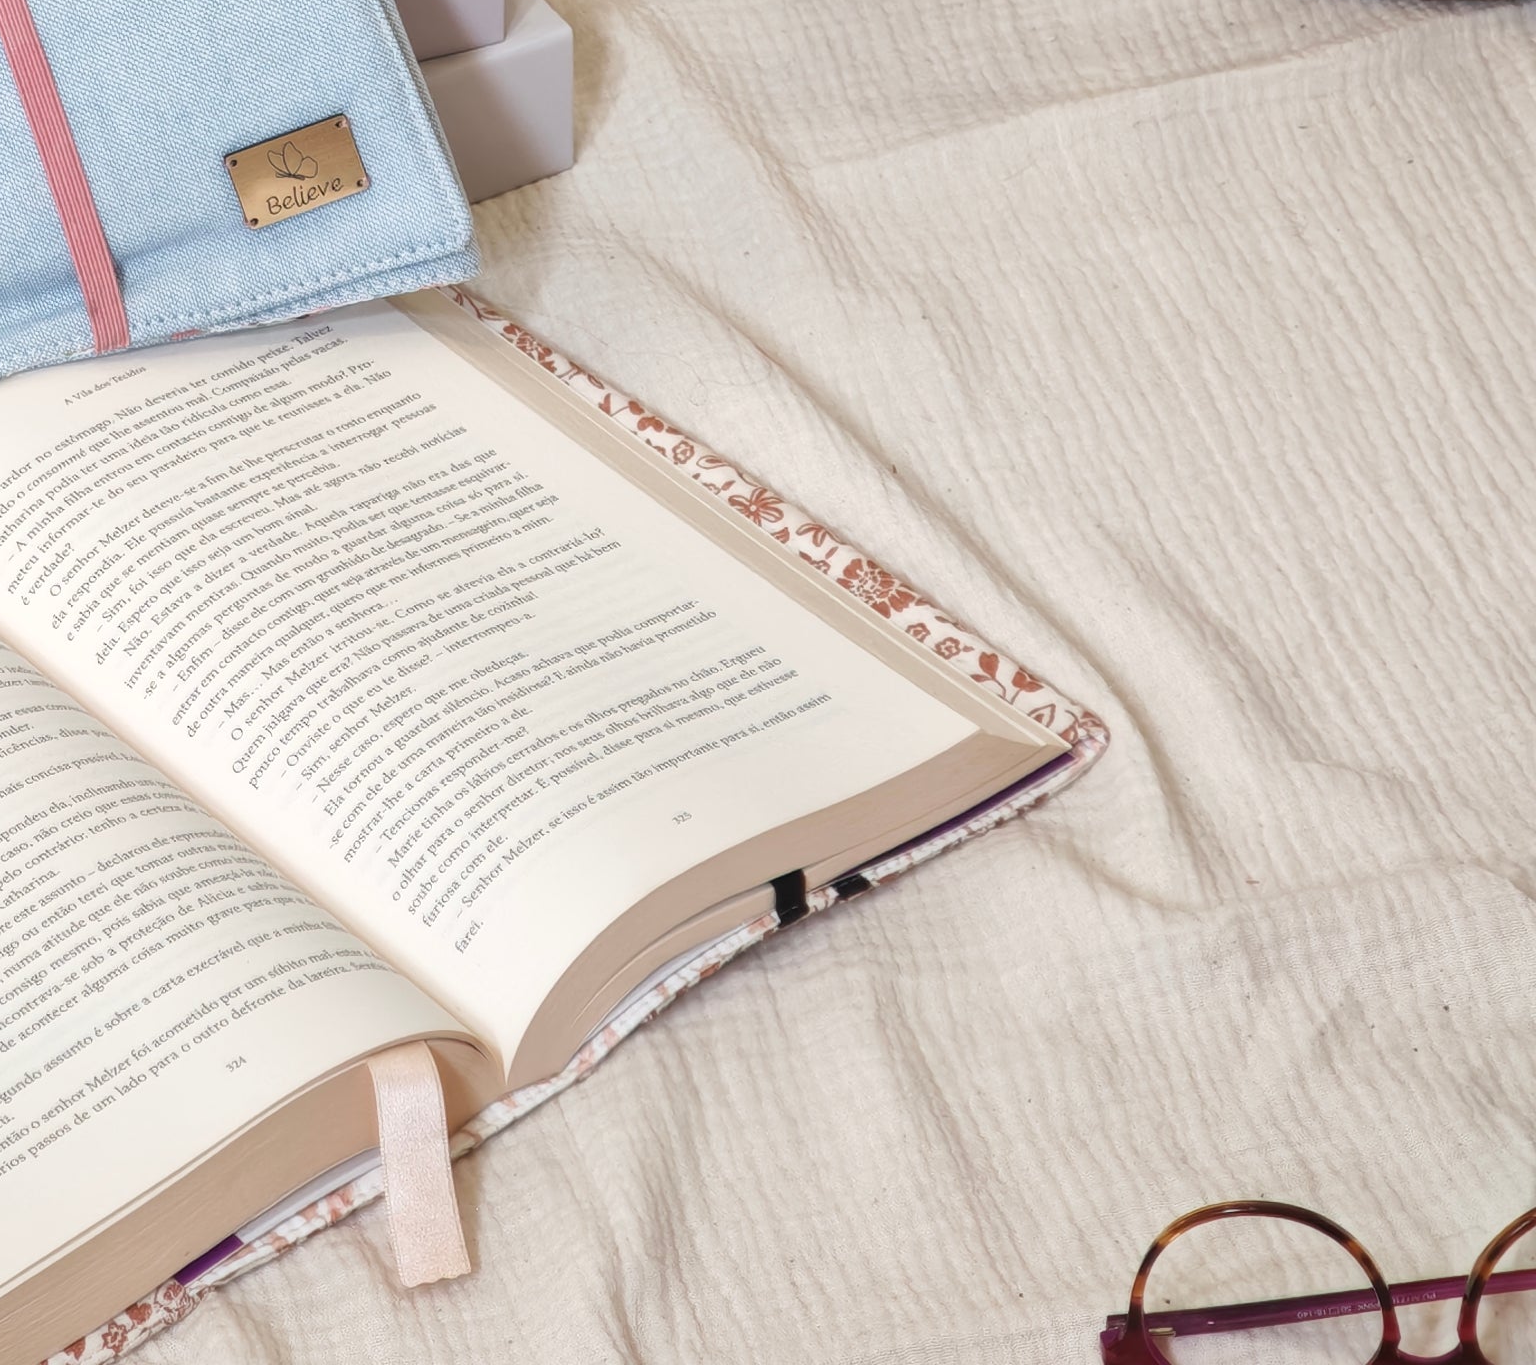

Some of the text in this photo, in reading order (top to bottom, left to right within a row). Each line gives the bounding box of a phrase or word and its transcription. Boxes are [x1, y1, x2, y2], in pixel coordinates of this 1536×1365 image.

[265, 177, 344, 215] Believe
[0, 462, 33, 490] ardor
[34, 450, 53, 464] no
[113, 405, 143, 420] Não
[144, 386, 190, 408] deveria
[188, 378, 208, 389] ter
[210, 359, 256, 381] comido
[291, 325, 335, 347] Talvez
[16, 490, 26, 499] o
[87, 437, 112, 453] que
[108, 427, 133, 440] lhe
[132, 404, 185, 431] assentou
[44, 473, 82, 502] podia
[79, 461, 99, 476] ter
[99, 447, 130, 465] uma
[126, 433, 160, 451] ideia
[158, 423, 181, 436] tão
[228, 390, 263, 407] como
[64, 398, 74, 406] A
[71, 389, 94, 400] Vila
[15, 541, 28, 552] A
[26, 505, 66, 540] minha
[63, 486, 94, 507] filha
[93, 463, 135, 488] entrou
[134, 452, 156, 466] em
[155, 429, 208, 455] contacto
[207, 410, 253, 432] contigo
[253, 404, 269, 414] de
[269, 389, 308, 408] algum
[461, 862, 504, 908] Senhor
[548, 817, 564, 830] se
[559, 802, 588, 820] isso
[586, 794, 597, 805] é
[596, 779, 633, 801] assim
[630, 768, 654, 782] tão
[672, 811, 692, 825] 325
[27, 1123, 72, 1159] passos
[73, 1111, 91, 1126] de
[91, 1094, 117, 1113] um
[113, 1073, 148, 1097] lado
[148, 1051, 180, 1078] para
[180, 1042, 191, 1053] o
[192, 1018, 230, 1044] outro
[230, 987, 287, 1020] defronte
[30, 1120, 41, 1129] o
[41, 1088, 86, 1124] senhor
[84, 1057, 132, 1093] Melzer
[130, 1043, 153, 1062] foi
[151, 1000, 220, 1048] acometido
[219, 986, 243, 1007] por
[243, 975, 268, 990] um
[225, 1056, 247, 1073] 324
